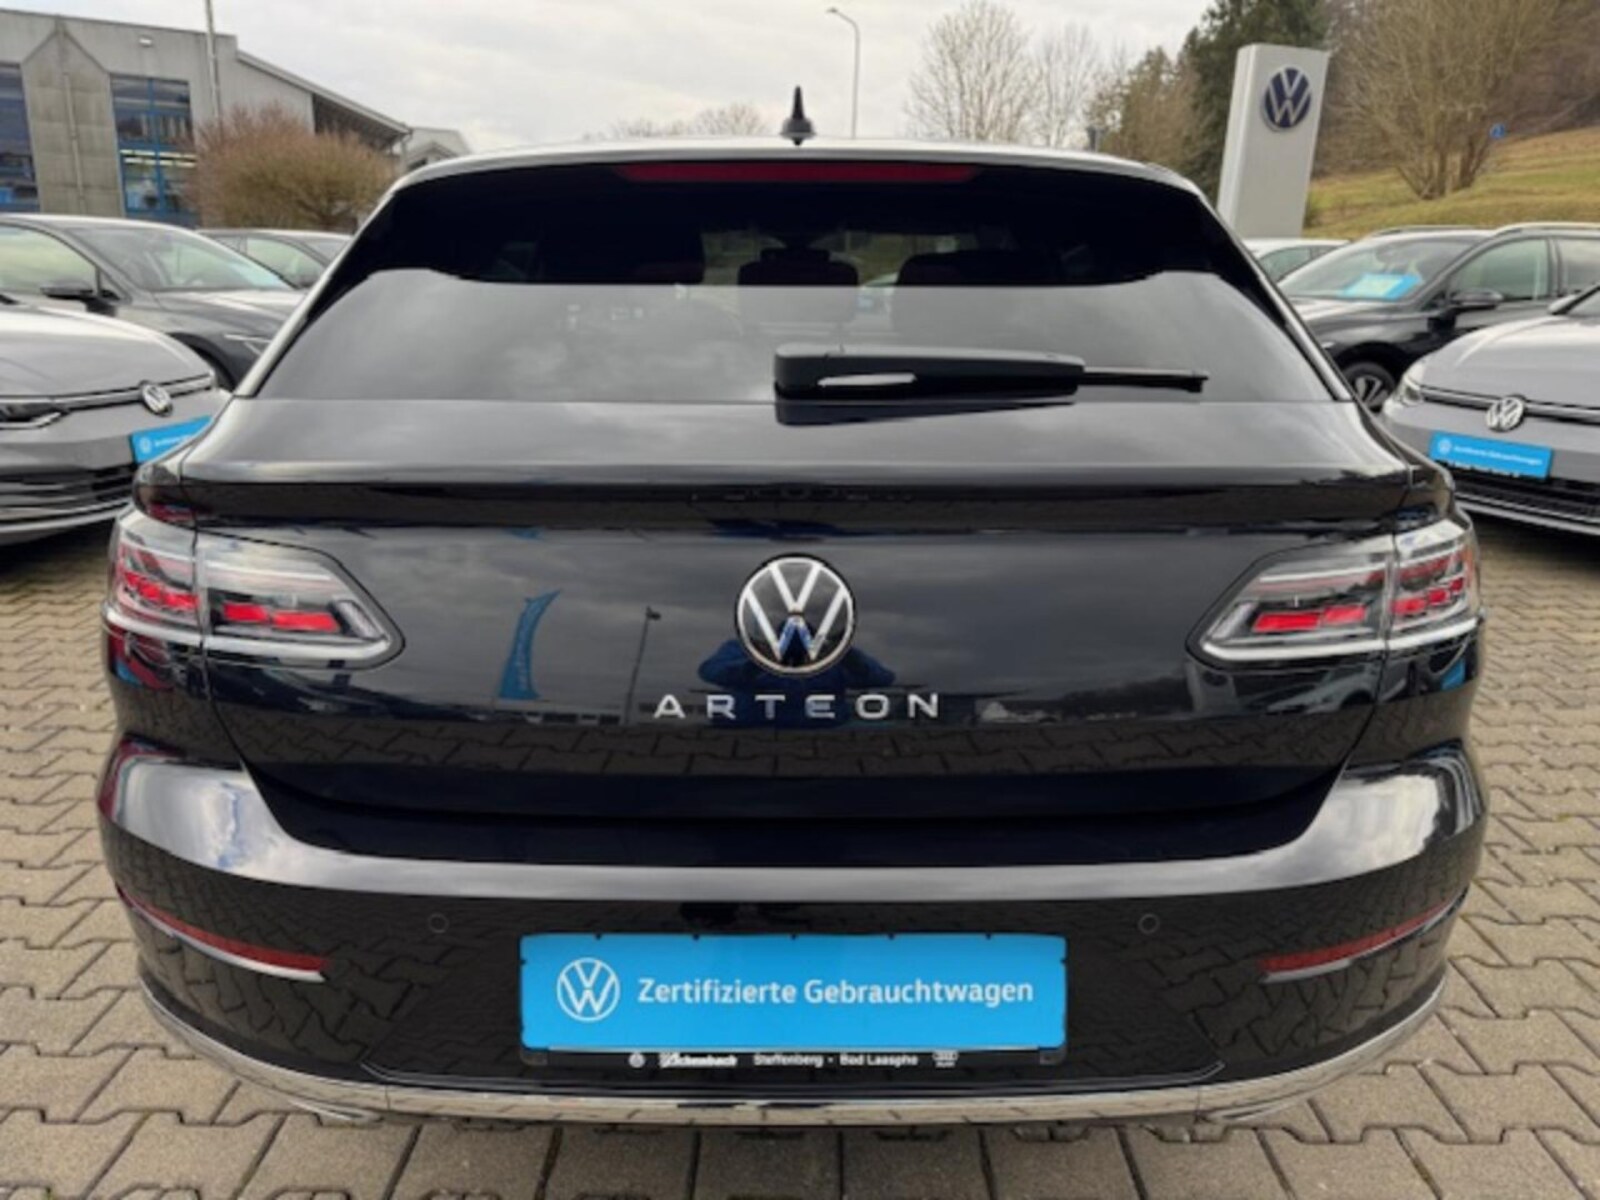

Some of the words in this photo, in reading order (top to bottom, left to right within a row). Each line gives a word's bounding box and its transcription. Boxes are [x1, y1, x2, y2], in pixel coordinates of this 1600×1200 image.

[737, 556, 854, 673] VW
[653, 693, 939, 719] ARTEON
[638, 978, 797, 1003] Zertifizierte
[804, 978, 1034, 1008] Gebrauchtwagen
[840, 1053, 864, 1066] Bad
